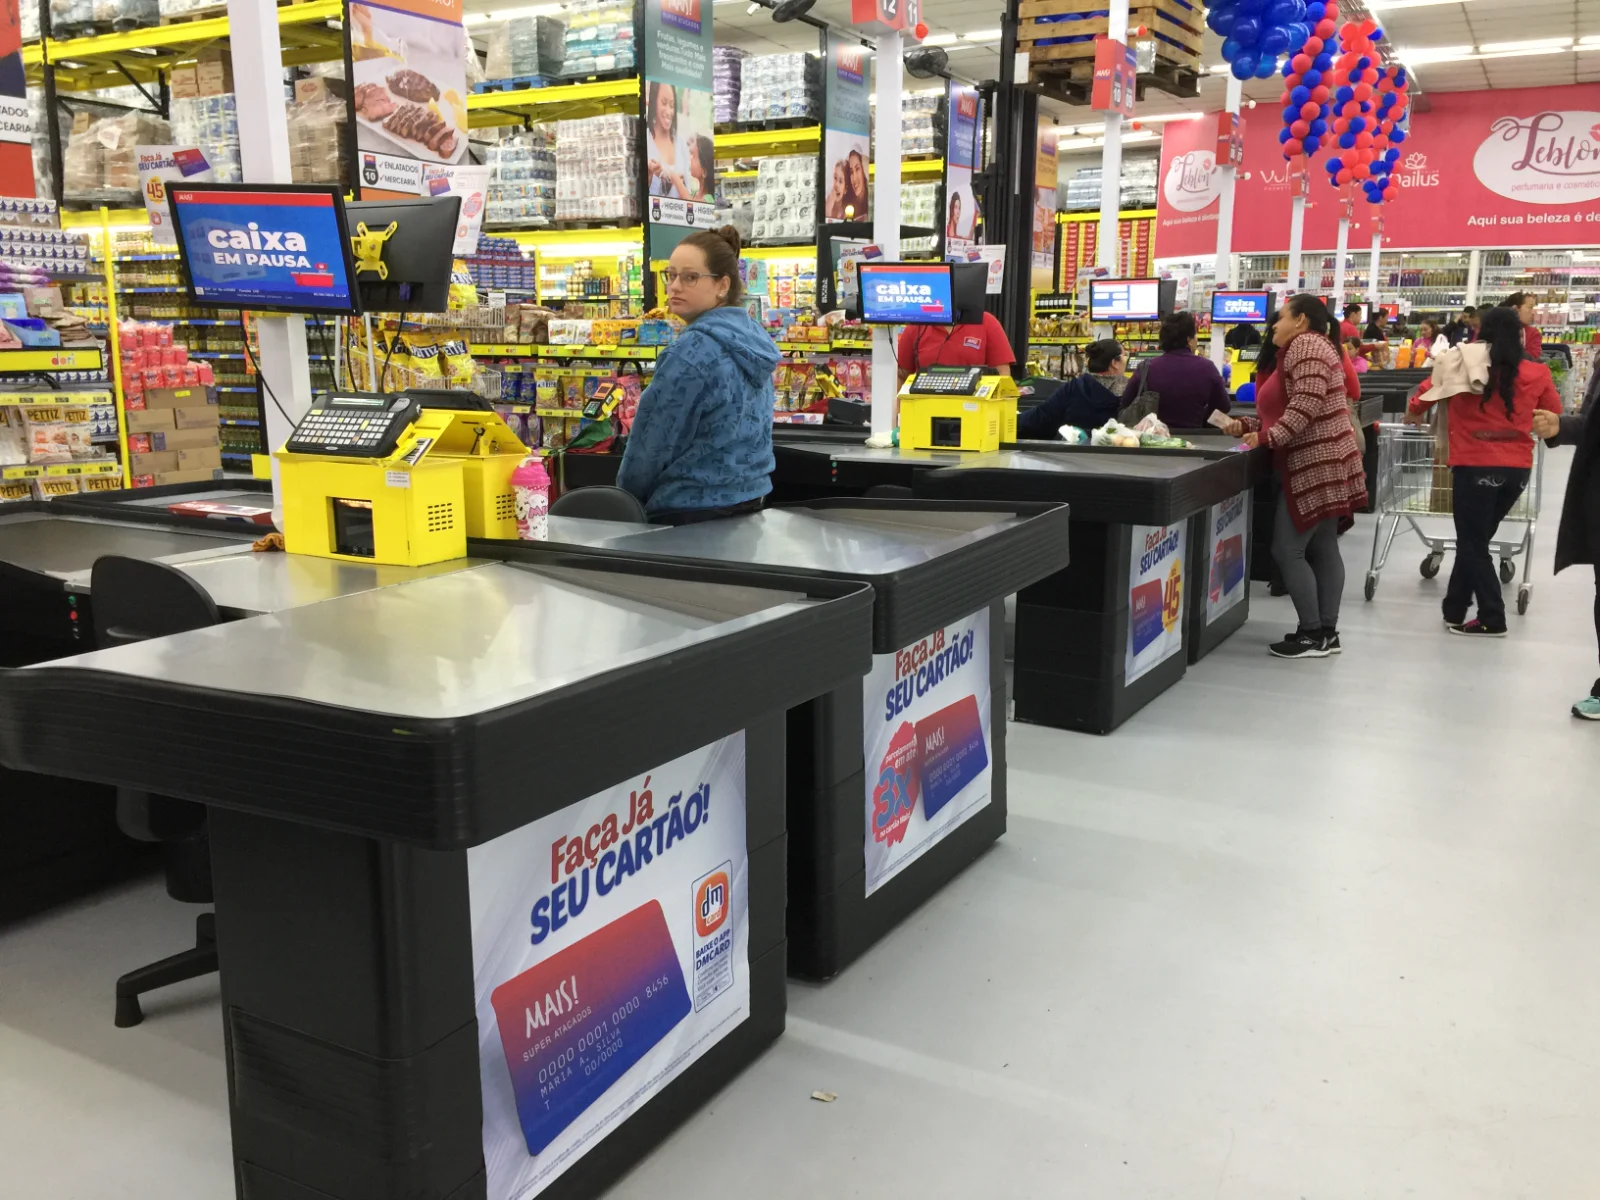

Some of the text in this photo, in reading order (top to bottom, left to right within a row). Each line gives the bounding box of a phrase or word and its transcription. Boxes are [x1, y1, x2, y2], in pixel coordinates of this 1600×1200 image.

[908, 2, 918, 24] 11
[365, 172, 376, 181] 10
[384, 161, 419, 173] ENLATADOS
[146, 183, 164, 199] 45
[384, 176, 417, 186] MERCEARIA
[1511, 182, 1554, 192] perfumaria
[665, 202, 684, 212] HIGIENE
[698, 206, 714, 215] HIGIEN
[1467, 214, 1497, 227] Aqui
[1500, 216, 1524, 225] sua
[1527, 213, 1570, 224] beleza
[1574, 212, 1582, 223] é
[207, 221, 307, 252] caixa
[213, 252, 312, 268] EM PAUSA
[876, 280, 932, 295] caixa
[895, 296, 933, 304] PAUSA
[1225, 298, 1255, 306] caixa
[27, 408, 60, 421] PETTIZ
[1, 484, 29, 497] PETTIZ
[43, 482, 74, 493] PETTIZ
[89, 477, 120, 490] PETTIZ
[1145, 530, 1159, 553] Faça
[1140, 550, 1153, 576] SEU
[1163, 574, 1181, 619] 45
[895, 639, 928, 682] Faça
[885, 674, 914, 722] SEU
[925, 726, 945, 754] MAIS!
[895, 756, 905, 769] em
[876, 766, 912, 829] 3x
[551, 775, 654, 884] Faça Já
[530, 866, 589, 945] SEU
[702, 885, 723, 917] dm
[707, 909, 721, 924] card
[696, 940, 713, 959] BAIXE
[720, 929, 731, 942] APP
[696, 938, 731, 971] DMCARD
[525, 975, 580, 1039] MAIS!
[523, 1006, 592, 1062] SUPER ATACADOS
[538, 1047, 575, 1084] 0000
[577, 1020, 609, 1052] 0001
[612, 996, 640, 1026] 0000
[645, 974, 669, 999] 8456
[540, 1069, 573, 1098] MARIA
[596, 1029, 621, 1052] SILVA
[584, 1039, 624, 1076] 00/0000
